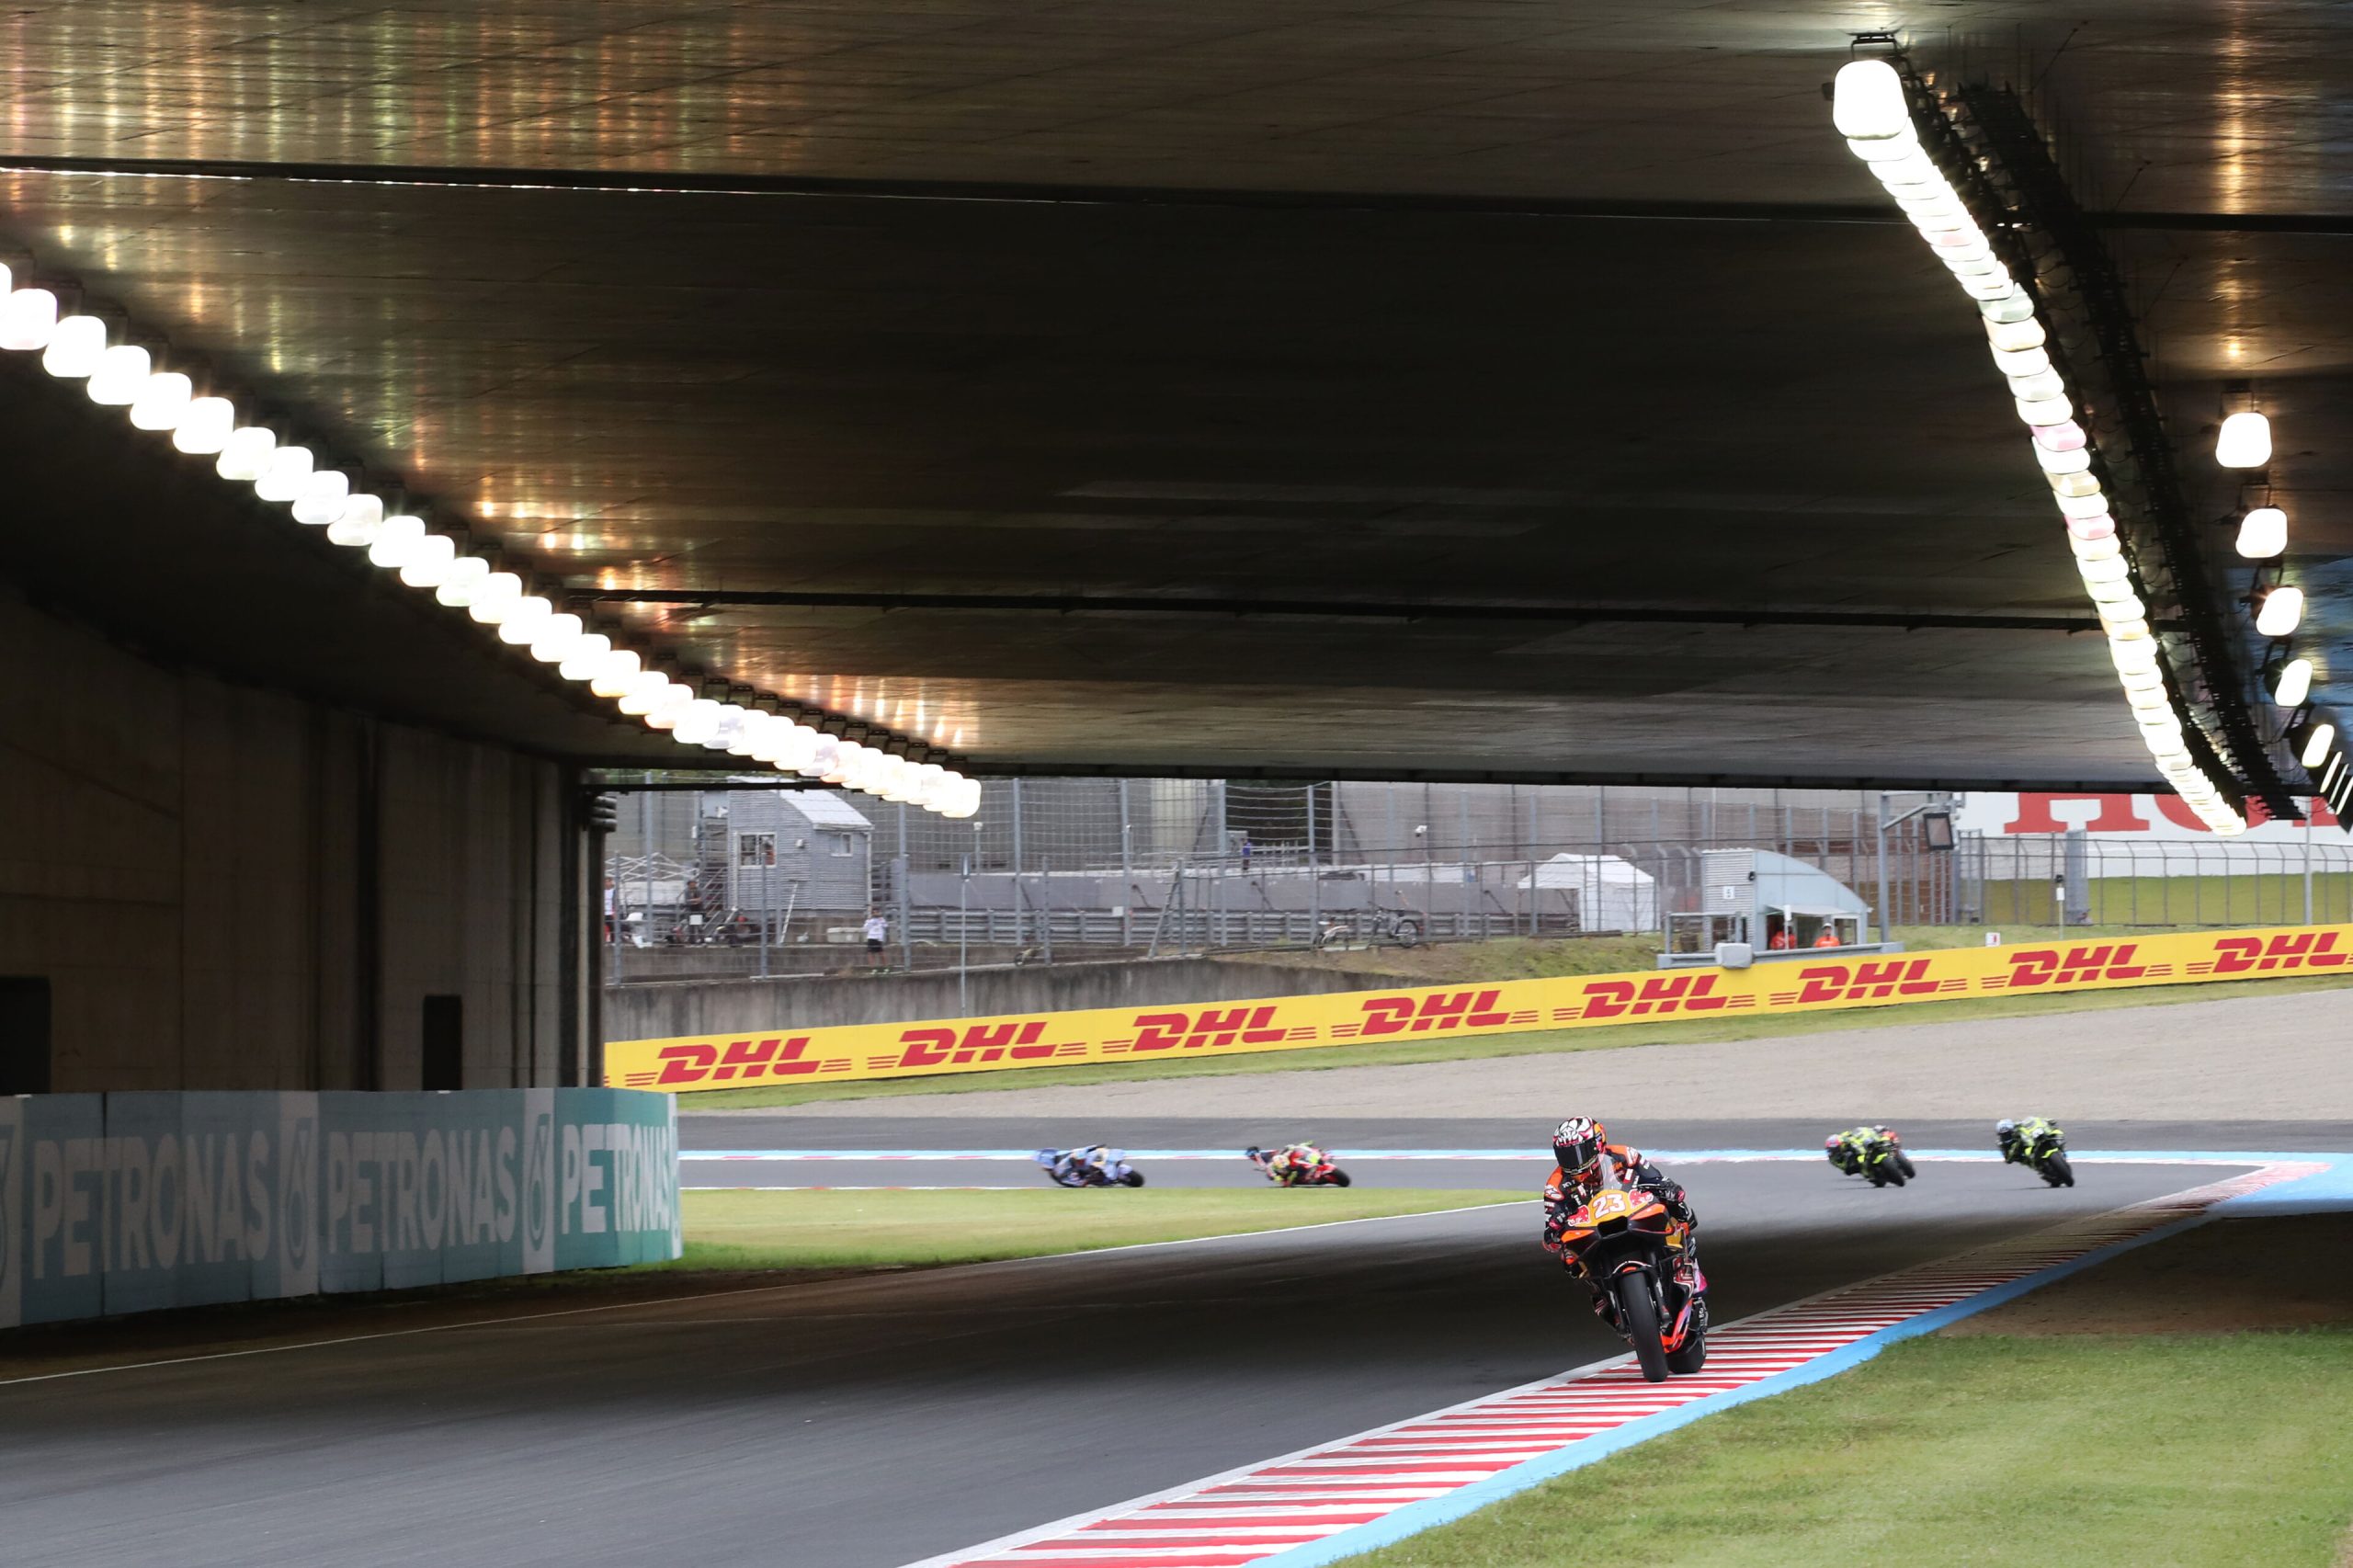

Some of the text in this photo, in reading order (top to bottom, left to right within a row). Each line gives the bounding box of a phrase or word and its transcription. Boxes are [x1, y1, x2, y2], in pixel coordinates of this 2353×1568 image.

[2008, 945, 2146, 987] DHL
[2212, 932, 2347, 972] DHL
[1583, 975, 1728, 1018] DHL
[1798, 960, 1939, 1003] DHL
[1132, 1006, 1287, 1051] DHL
[1361, 991, 1510, 1035] DHL
[658, 1038, 820, 1084] DHL
[899, 1022, 1057, 1067] DHL
[327, 1125, 517, 1254] PETRONAS
[562, 1123, 671, 1234] PETRONAS
[33, 1131, 270, 1279] PETRONAS
[1593, 1193, 1626, 1219] 23
